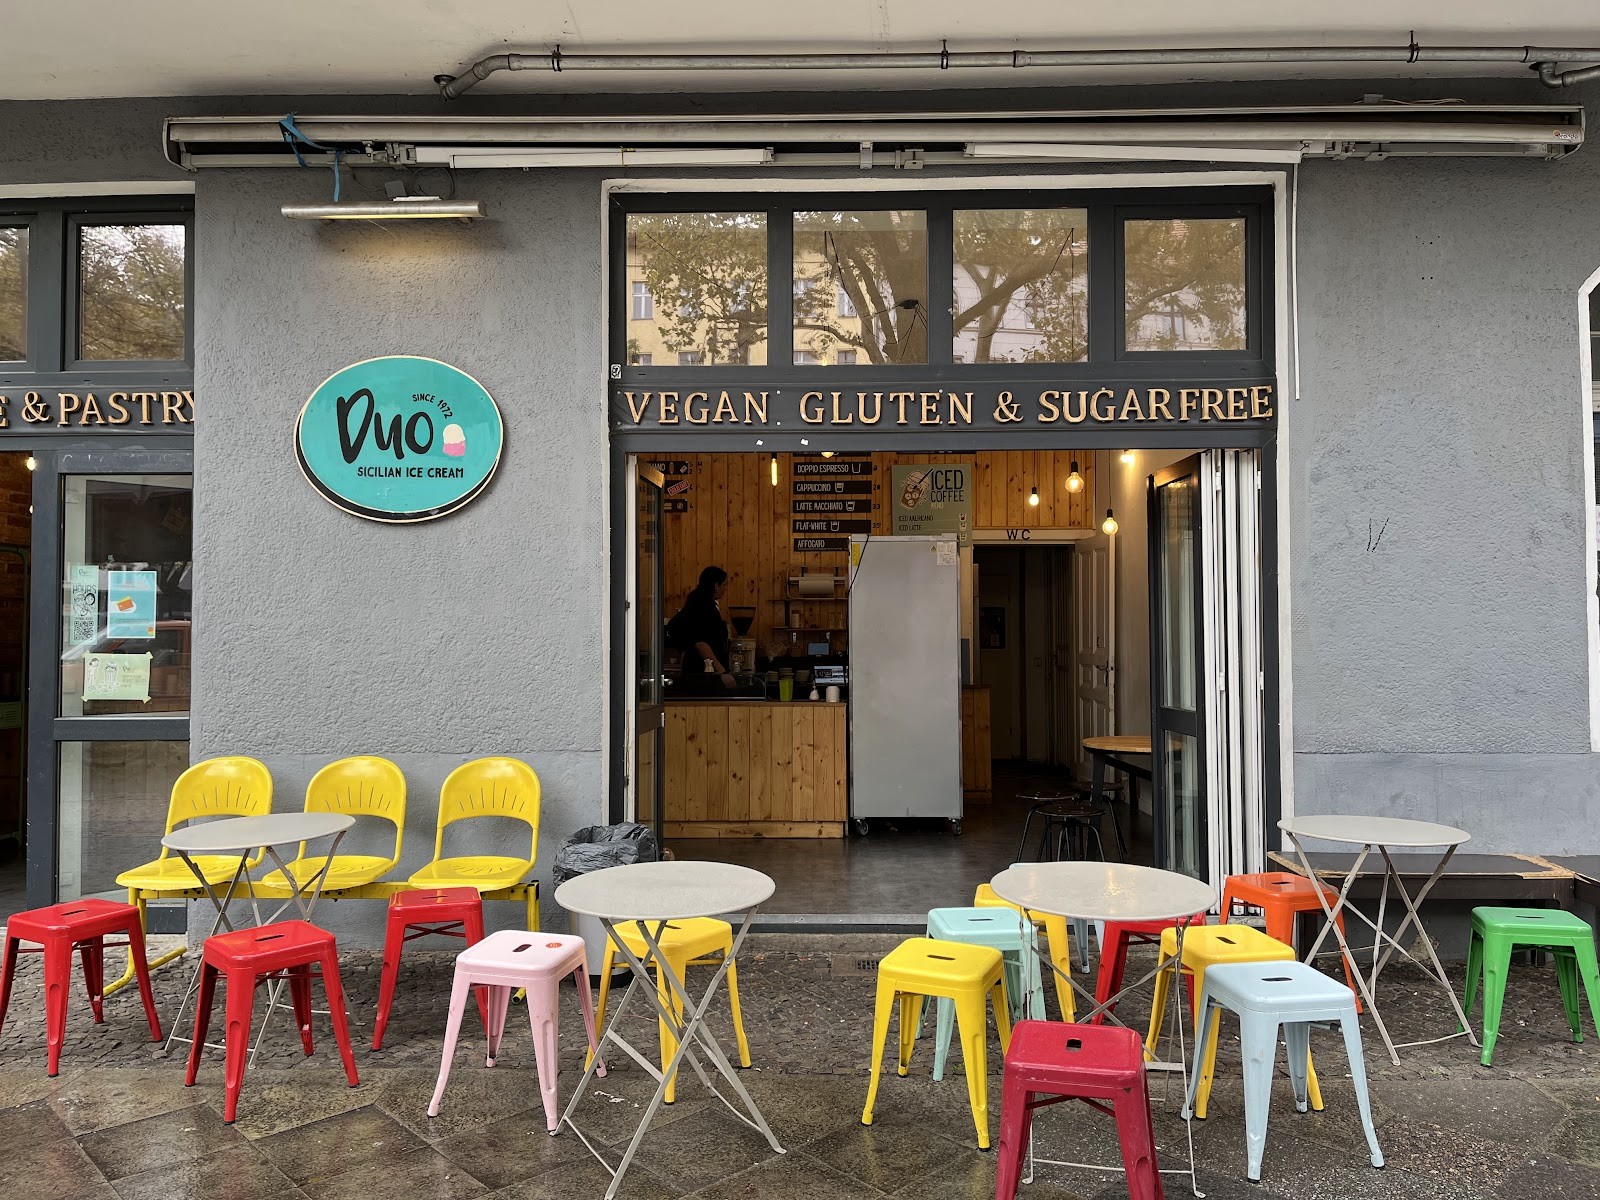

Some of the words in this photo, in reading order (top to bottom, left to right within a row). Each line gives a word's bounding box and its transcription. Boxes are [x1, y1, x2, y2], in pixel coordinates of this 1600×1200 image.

[21, 391, 50, 423] &
[412, 393, 436, 403] SINCE
[437, 399, 453, 419] 1972
[624, 390, 769, 425] VEGAN
[799, 390, 974, 425] GLUTEN
[992, 390, 1024, 424] &
[357, 466, 402, 478] SICILIAN
[405, 467, 424, 478] ICE
[427, 467, 464, 479] CREAM
[797, 464, 819, 474] DOPPIO
[819, 464, 849, 474] ESPRESSO
[931, 469, 964, 491] ICED
[796, 483, 832, 492] CAPPUCCINO
[930, 490, 965, 503] COFFEE
[796, 502, 813, 511] LATTE
[813, 502, 843, 511] MACCHIATO
[1006, 528, 1031, 541] WC
[797, 539, 826, 548] AFFOGATO
